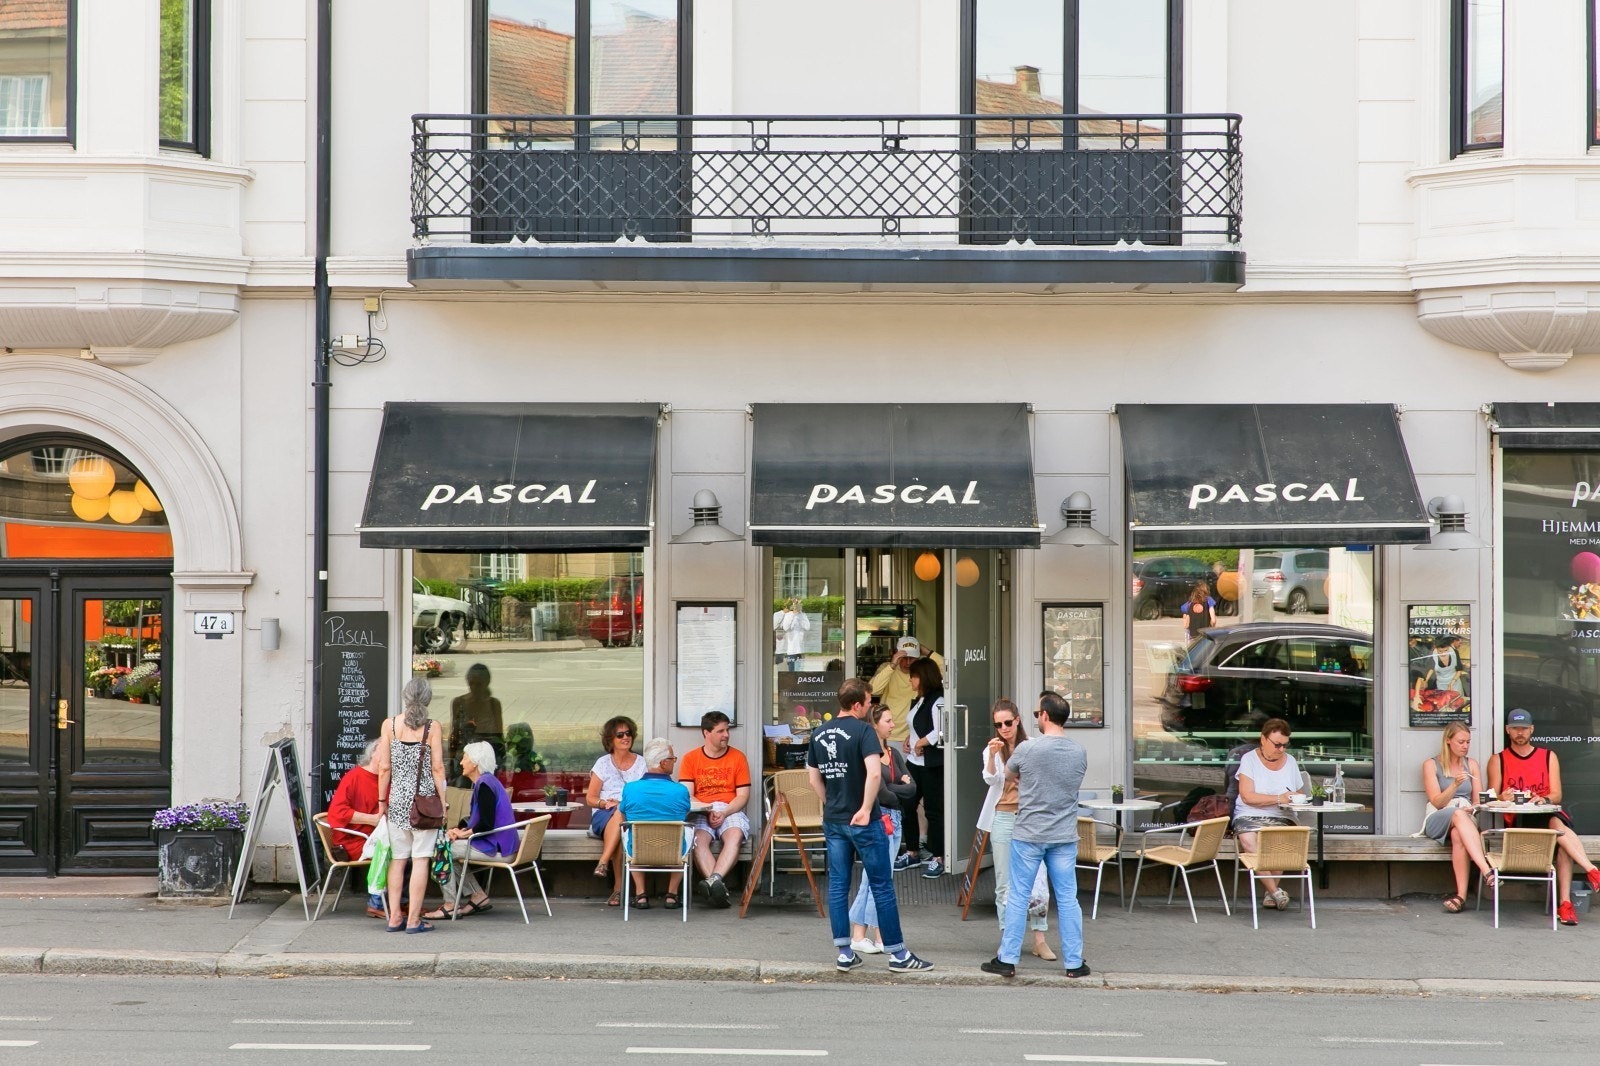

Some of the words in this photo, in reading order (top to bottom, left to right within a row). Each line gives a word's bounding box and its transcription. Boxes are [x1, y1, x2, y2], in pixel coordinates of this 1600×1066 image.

[420, 479, 597, 511] PASCAL
[805, 480, 981, 510] PASCAL
[1188, 477, 1365, 509] PASCAL
[1057, 611, 1088, 620] PASCAL
[1414, 618, 1457, 626] MATKURS
[1458, 618, 1465, 626] &
[200, 616, 218, 630] 47
[220, 619, 227, 630] a
[325, 616, 383, 645] PASCAL
[1409, 627, 1471, 635] DESSERTKURS
[1570, 629, 1600, 639] PASC
[964, 646, 987, 666] PASCAL
[797, 676, 825, 684] PASCAL
